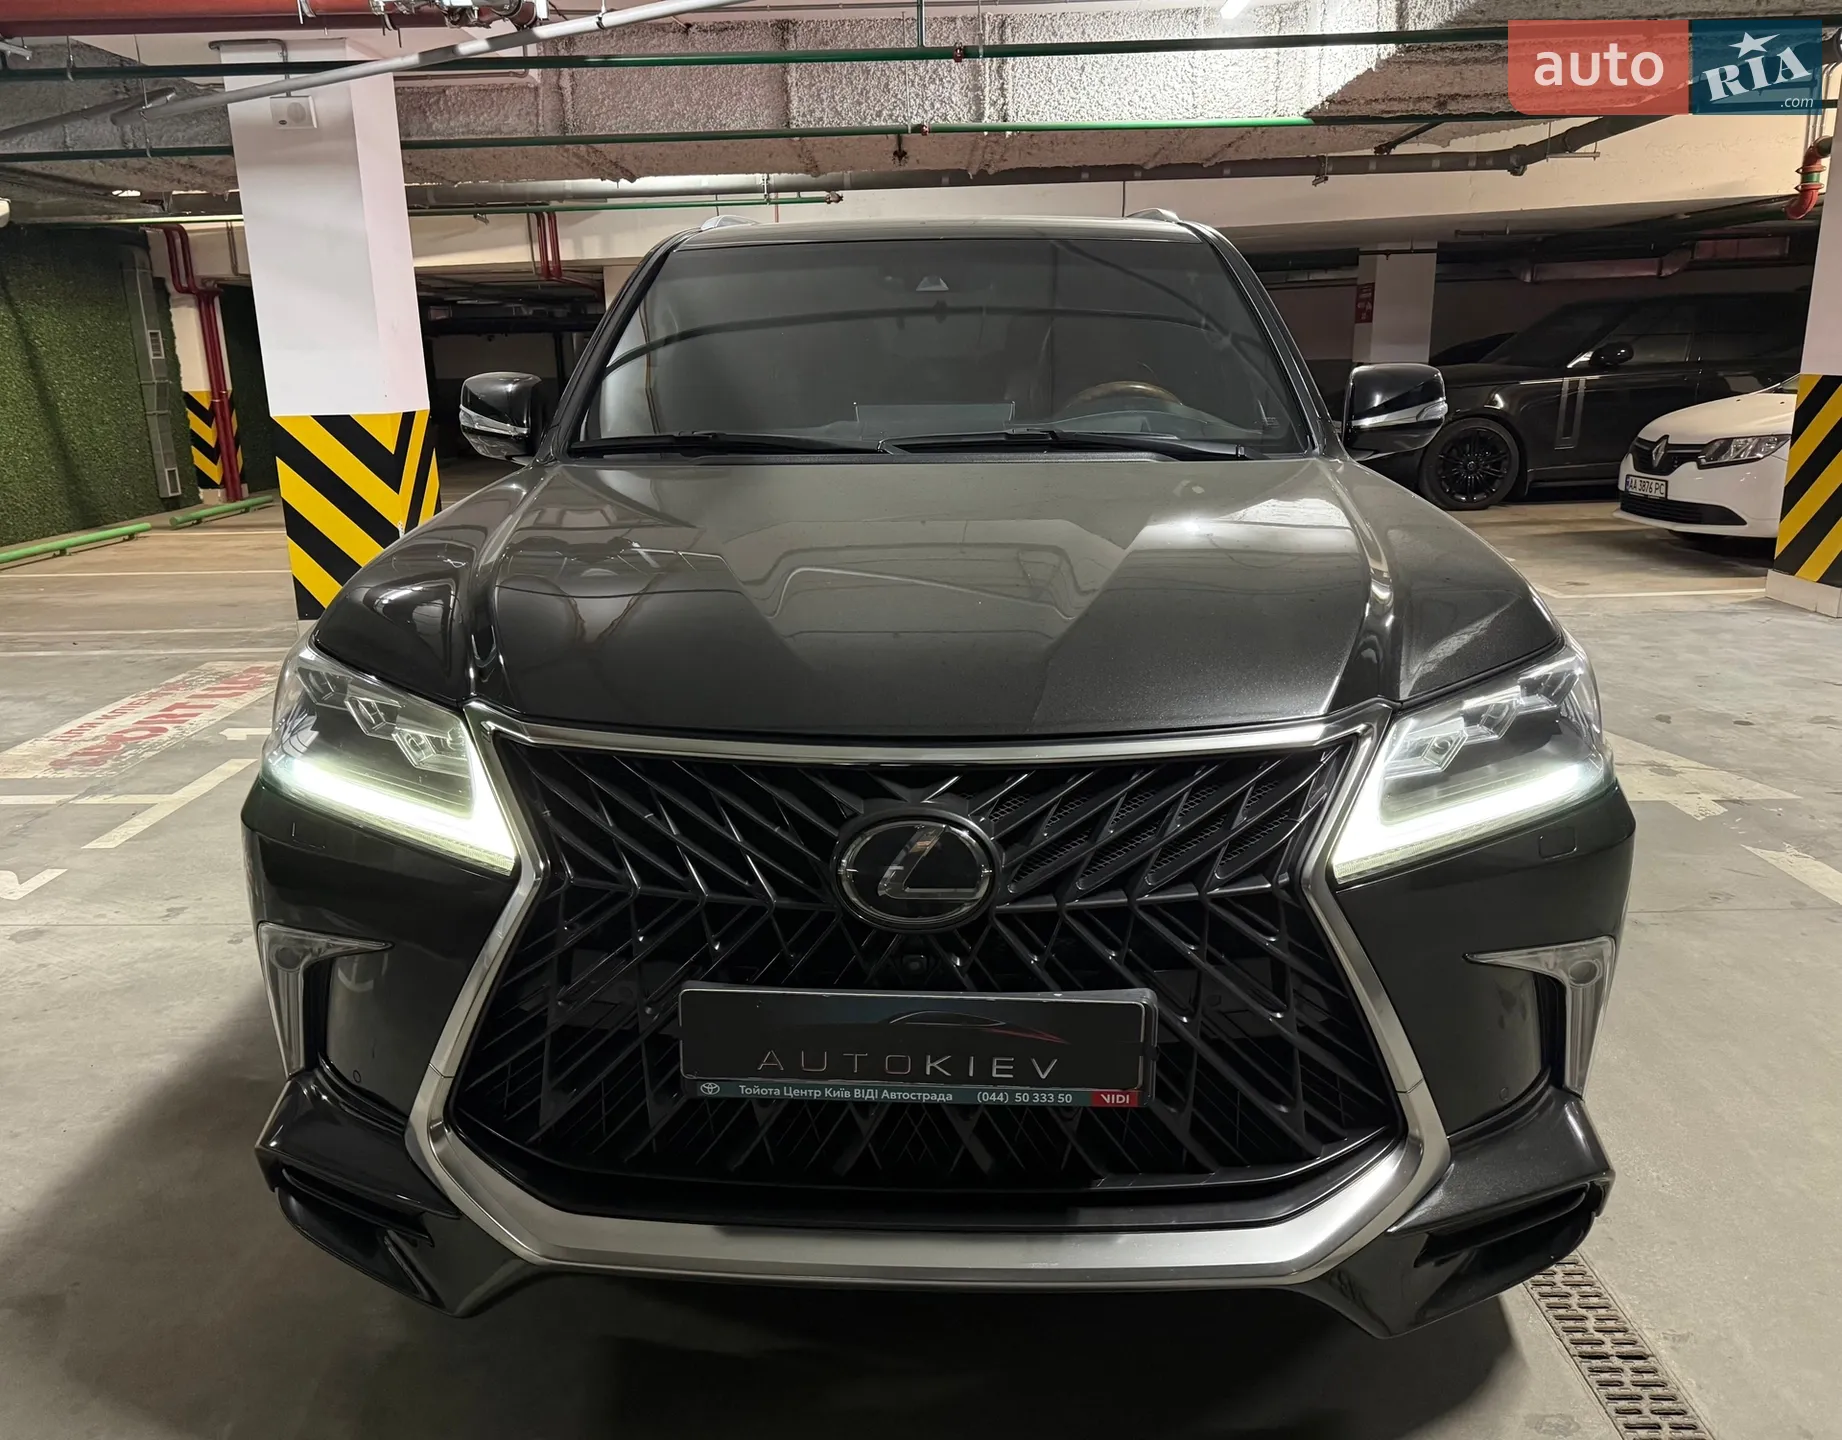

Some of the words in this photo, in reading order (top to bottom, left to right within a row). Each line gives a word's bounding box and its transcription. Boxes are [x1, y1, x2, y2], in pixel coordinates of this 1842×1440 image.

[1638, 480, 1653, 494] 3876
[757, 1050, 1058, 1080] AUTOKIEV
[739, 1085, 781, 1096] Тойота
[783, 1086, 822, 1099] Центр
[824, 1087, 851, 1098] Київ
[853, 1088, 878, 1100] ВІДІ
[881, 1089, 953, 1103] Автострада
[977, 1091, 1009, 1104] (044)
[1015, 1092, 1030, 1103] 50
[1032, 1093, 1055, 1103] 333
[1057, 1094, 1073, 1104] 50
[1100, 1094, 1130, 1104] VIDI
